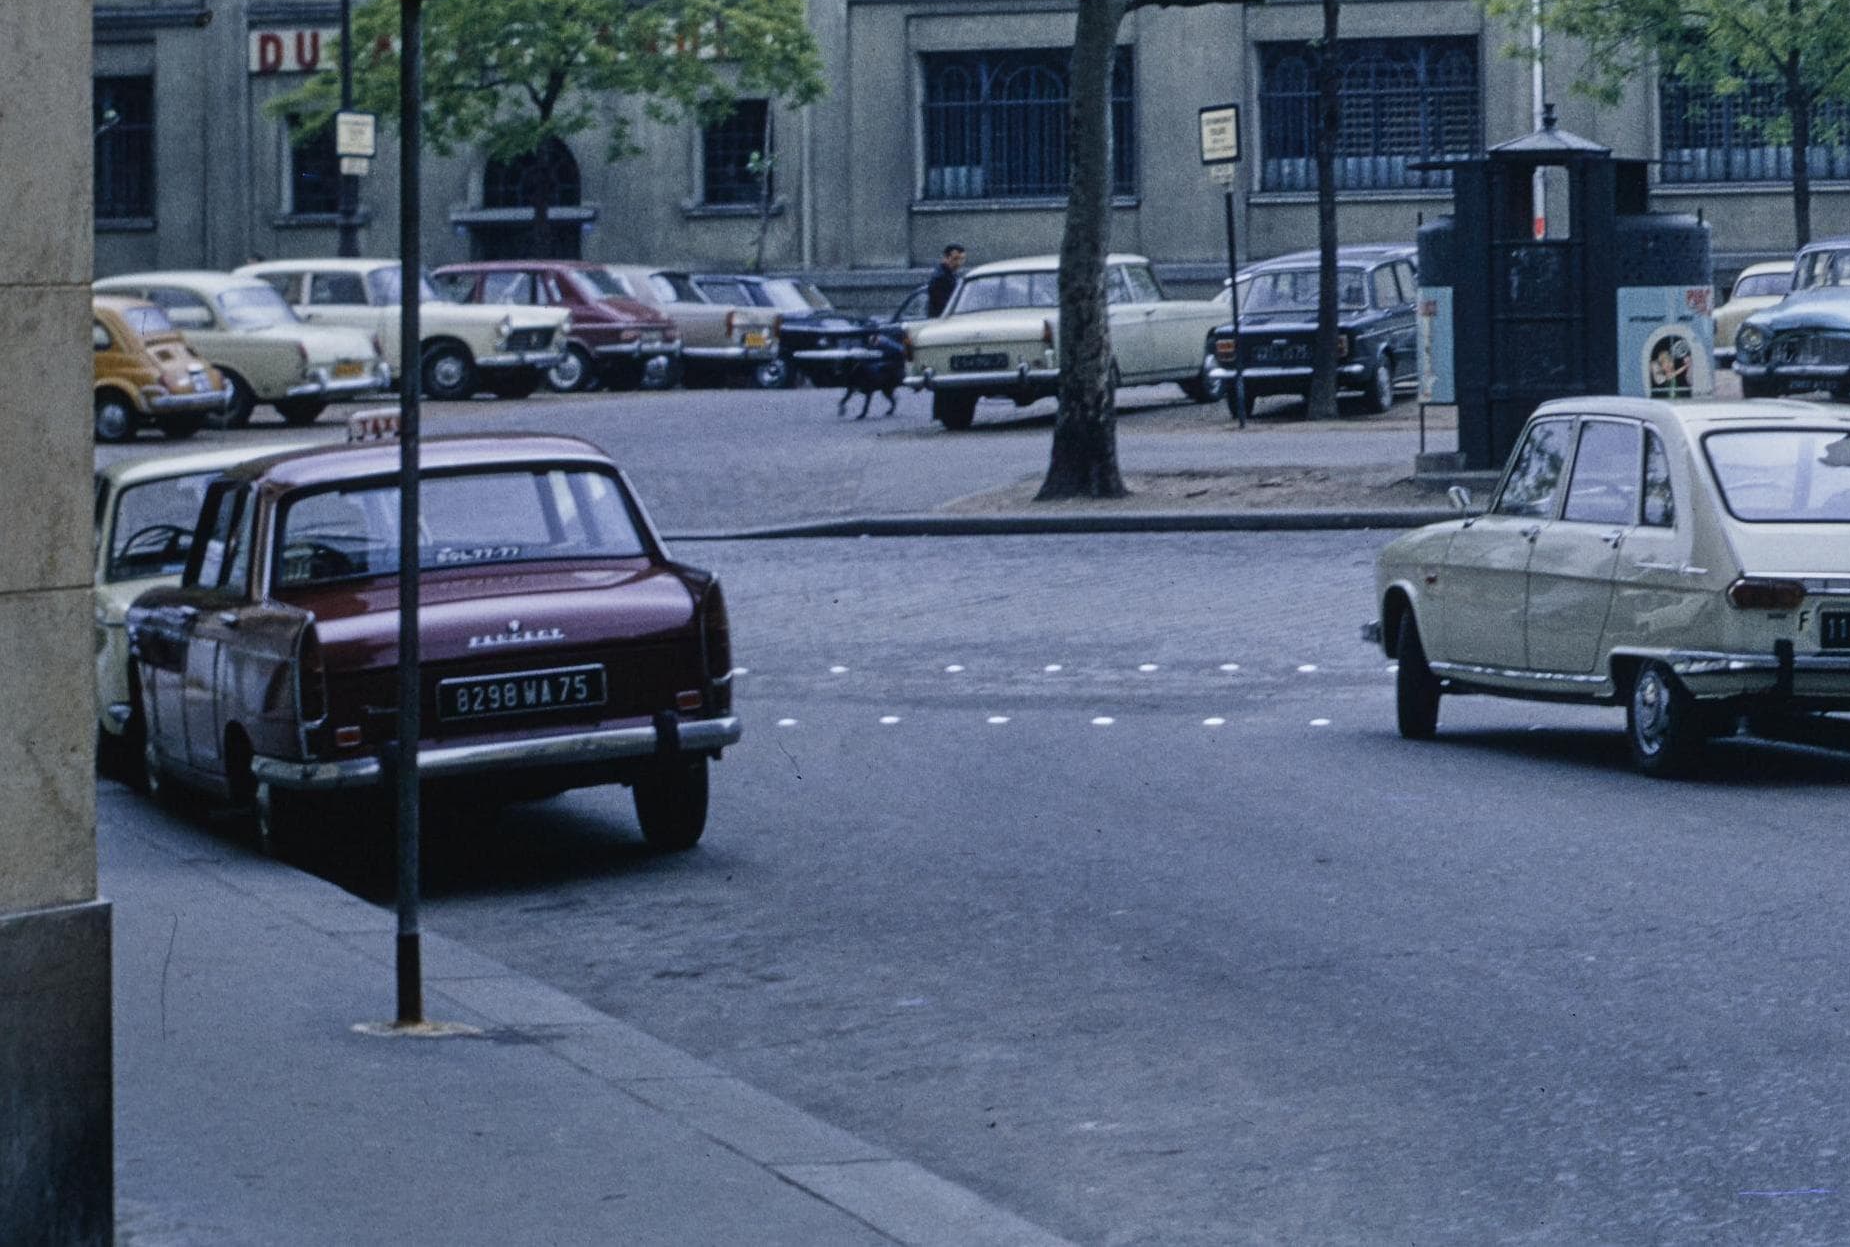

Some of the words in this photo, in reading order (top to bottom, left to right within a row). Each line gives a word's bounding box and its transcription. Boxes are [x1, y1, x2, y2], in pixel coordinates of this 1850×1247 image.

[456, 681, 519, 712] 8298
[523, 679, 552, 706] WA
[559, 674, 588, 702] 75
